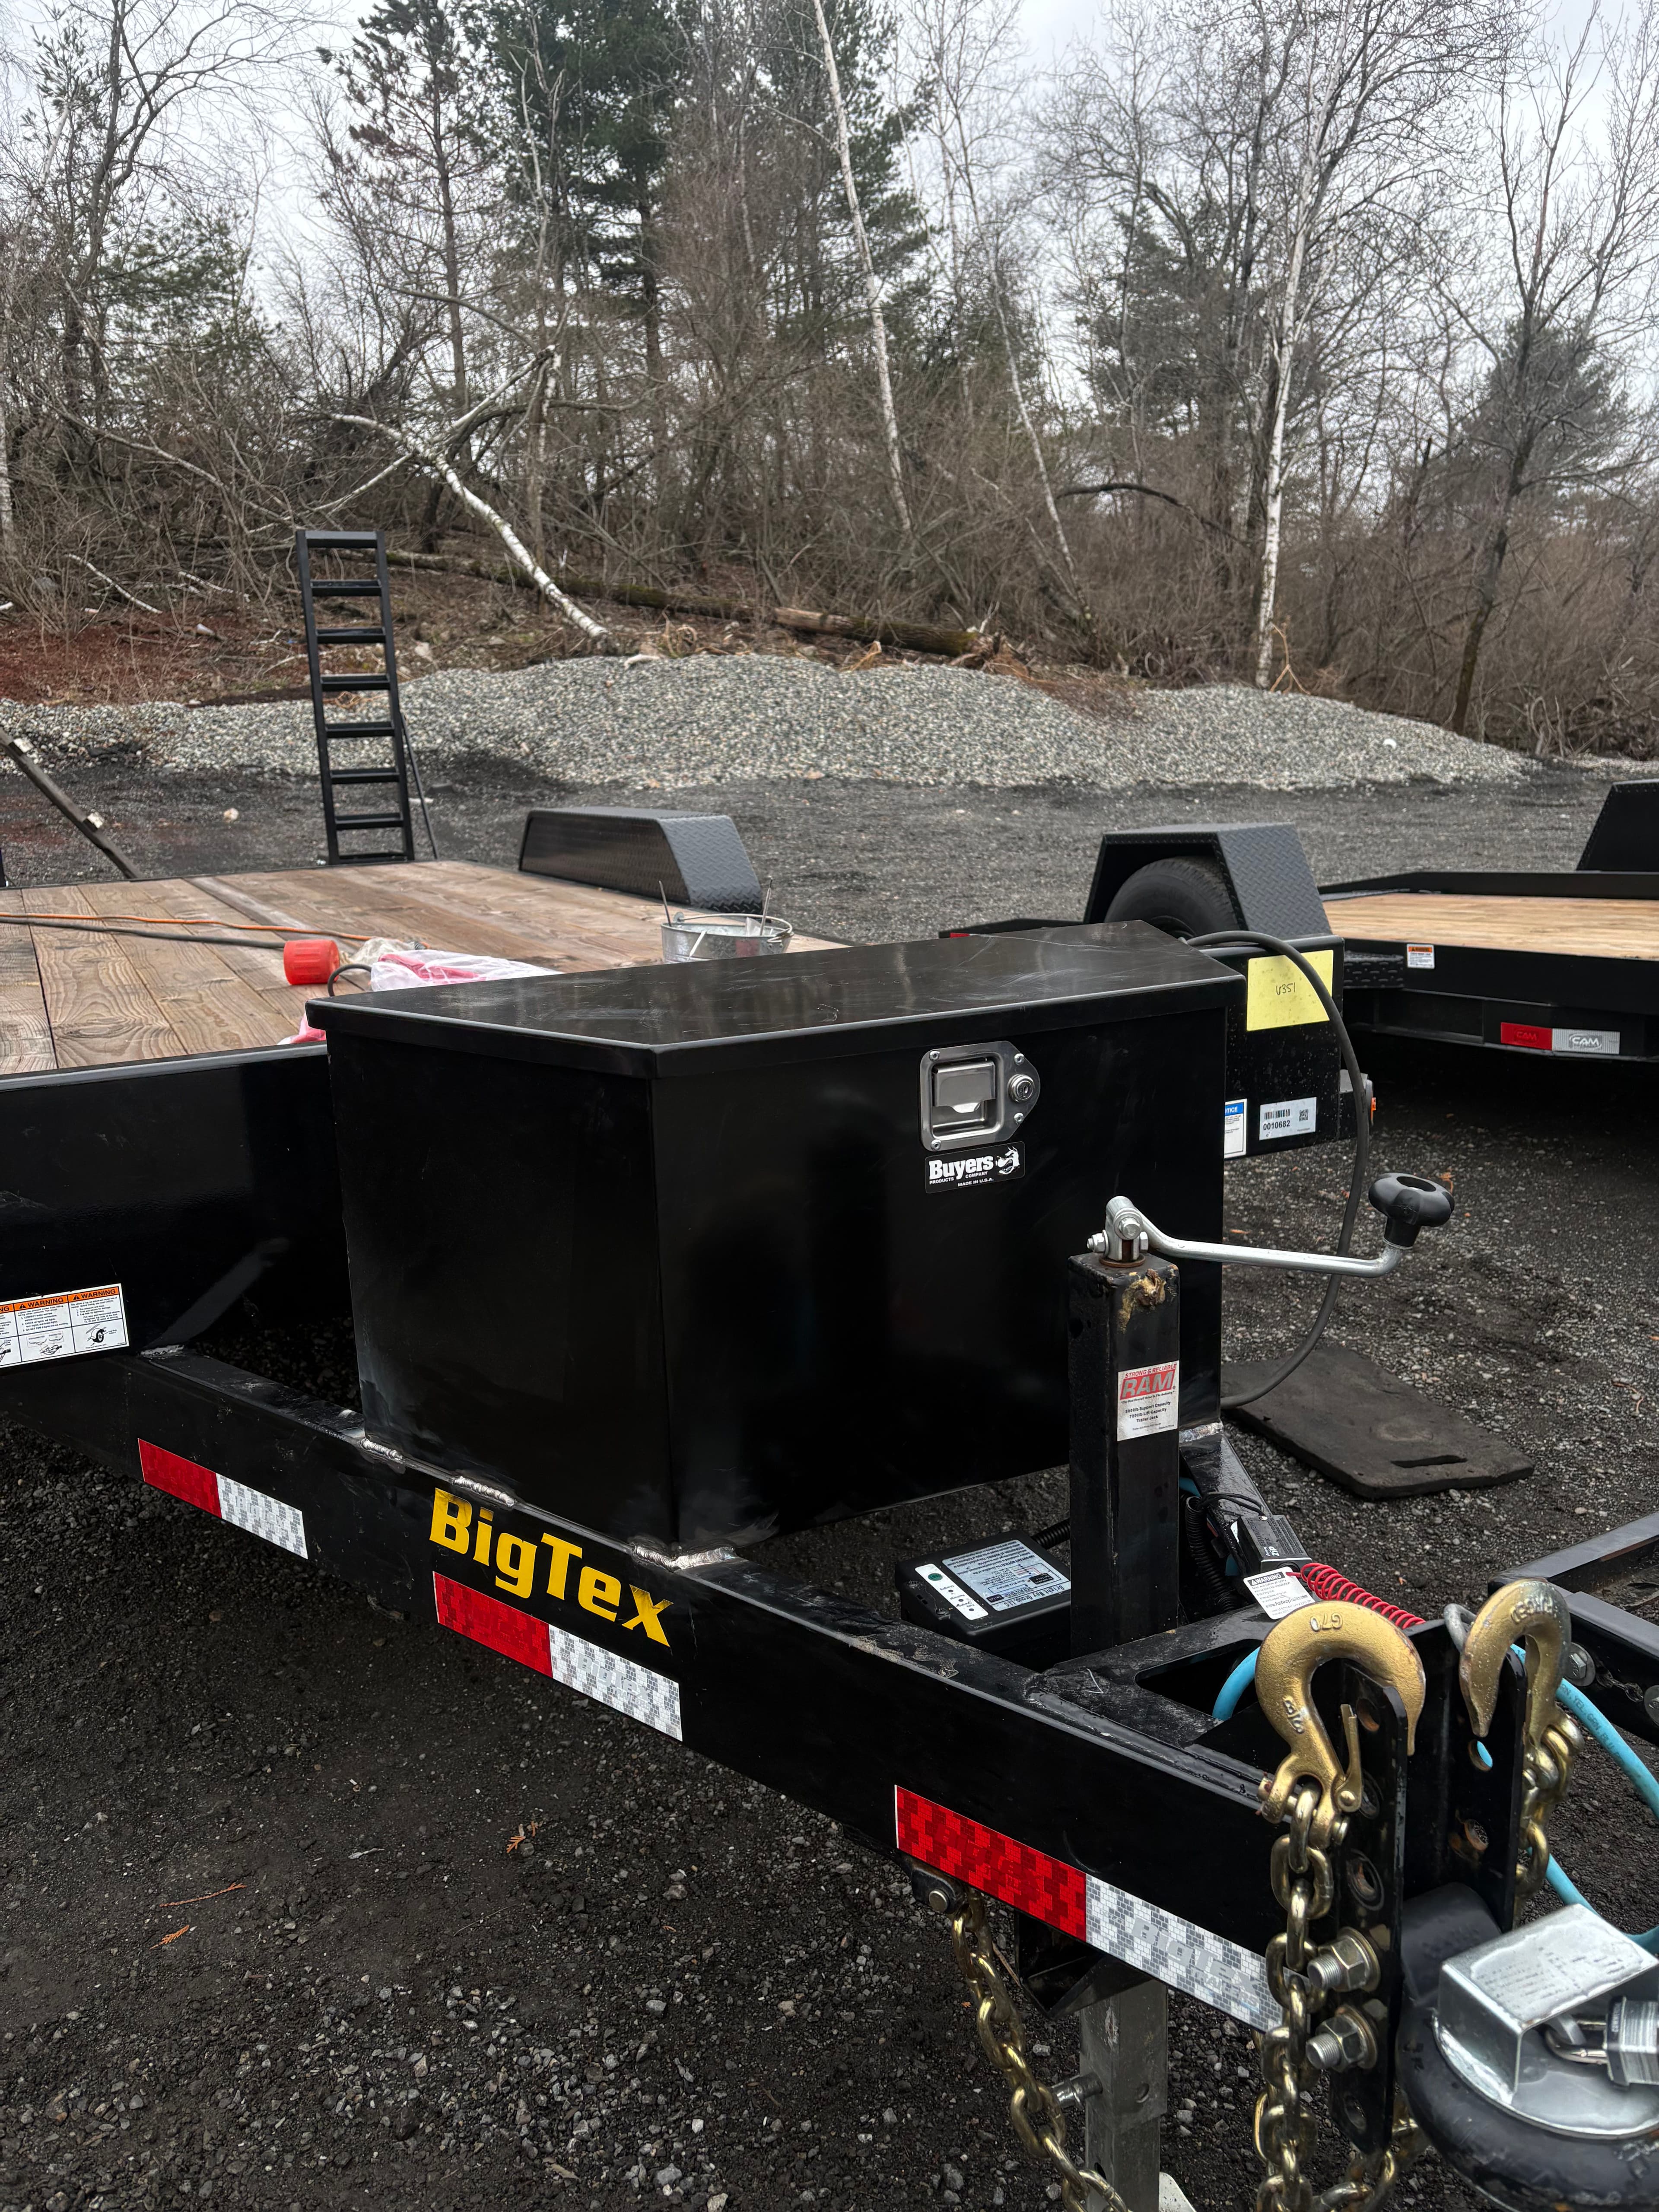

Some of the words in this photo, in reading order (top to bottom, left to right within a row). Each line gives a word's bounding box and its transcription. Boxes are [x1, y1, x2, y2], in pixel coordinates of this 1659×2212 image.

[1572, 1036, 1599, 1046] CAM
[1263, 1120, 1290, 1131] 0010682
[929, 1156, 994, 1180] Buyers
[81, 1289, 116, 1299] WARNING
[27, 1298, 64, 1307] WARNING
[1152, 1363, 1176, 1373] RELIABLE
[1122, 1373, 1173, 1398] RAM
[429, 1487, 674, 1647] BigTex
[1255, 1573, 1282, 1584] WARNING
[1042, 1584, 1064, 1594] Bright
[1309, 1612, 1344, 1632] G70
[577, 1653, 653, 1701] BigTex
[1131, 1918, 1261, 1995] BigTex
